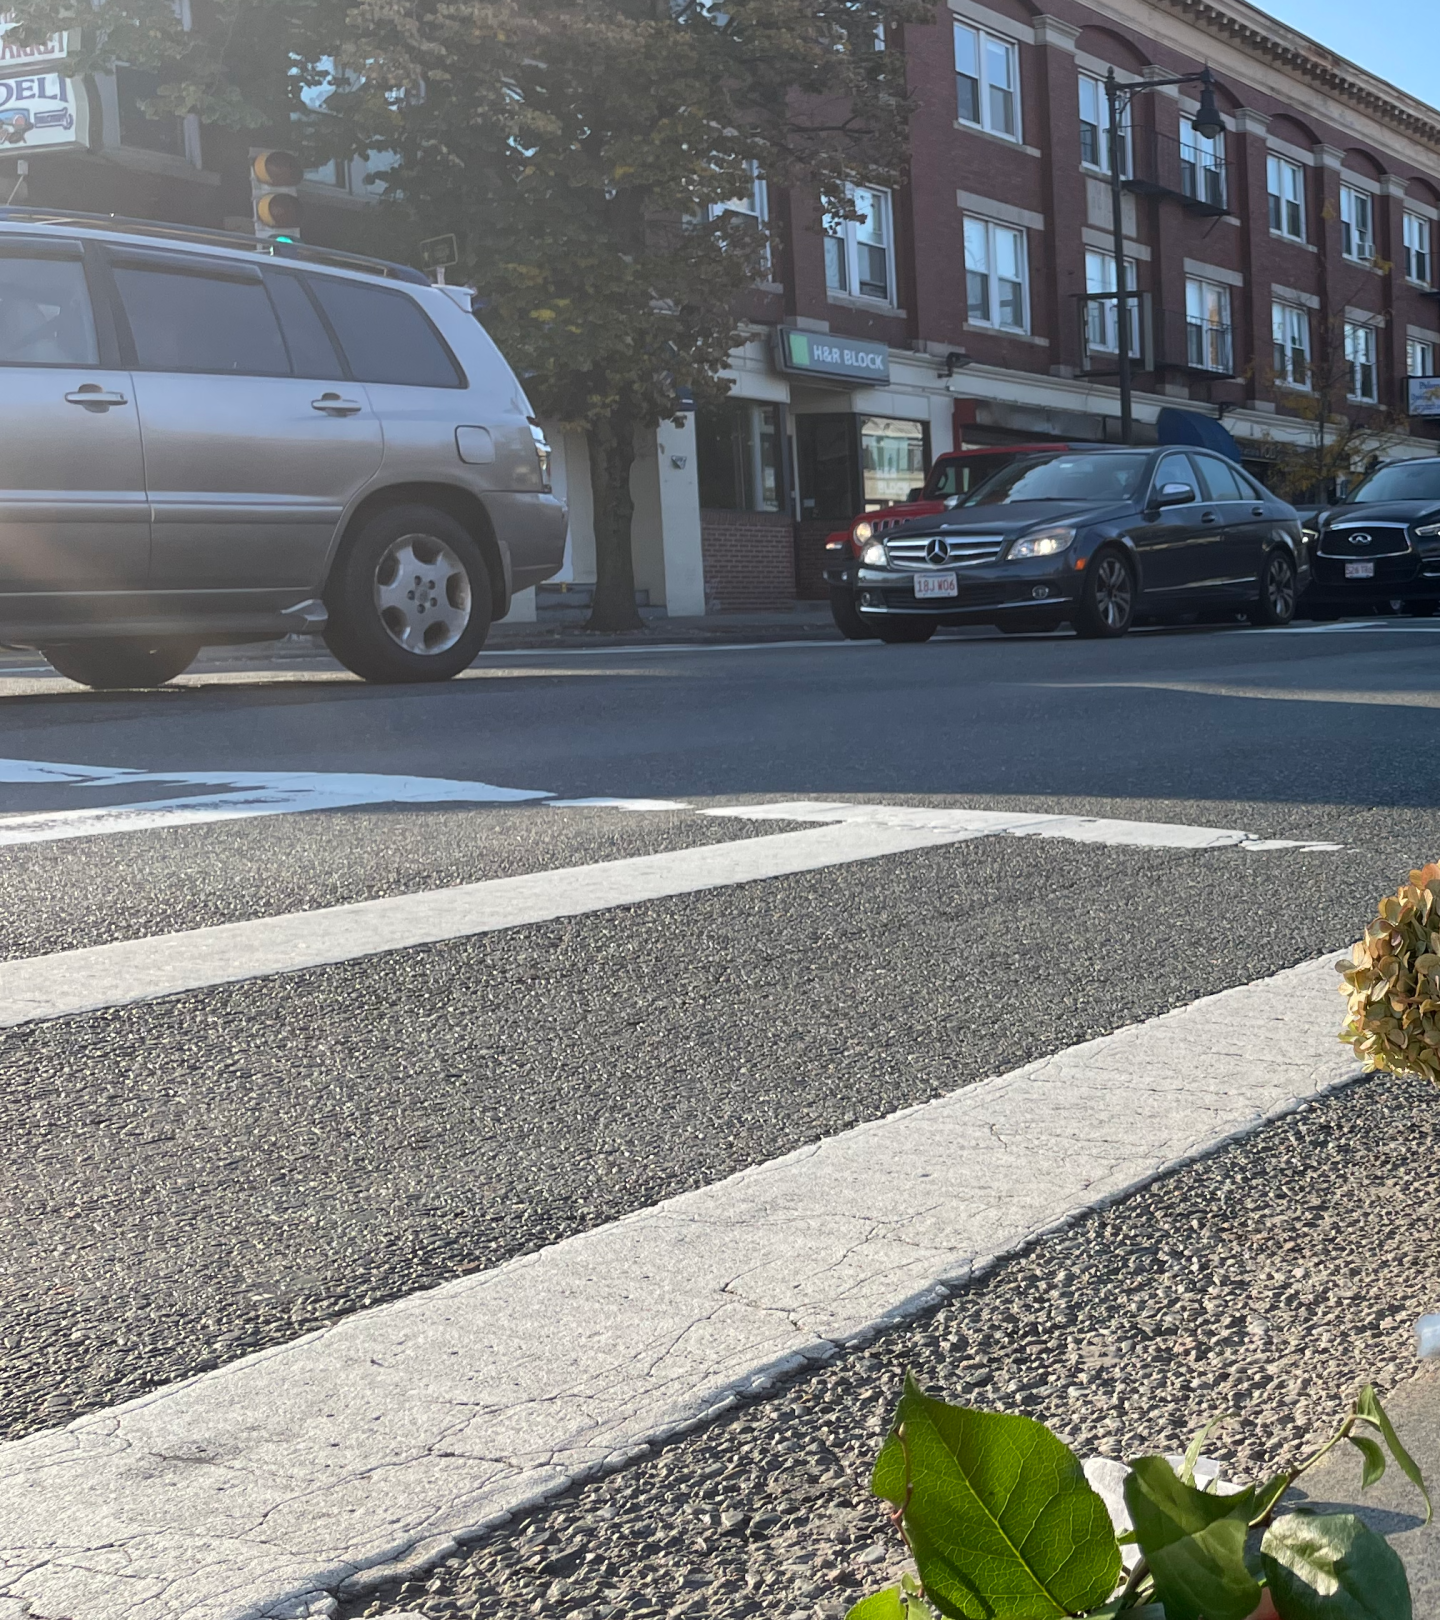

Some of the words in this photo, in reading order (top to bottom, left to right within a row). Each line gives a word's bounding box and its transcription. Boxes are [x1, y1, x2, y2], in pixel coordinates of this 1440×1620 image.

[0, 76, 69, 107] DELI
[813, 345, 840, 363] H&R
[843, 349, 884, 370] BLOCK
